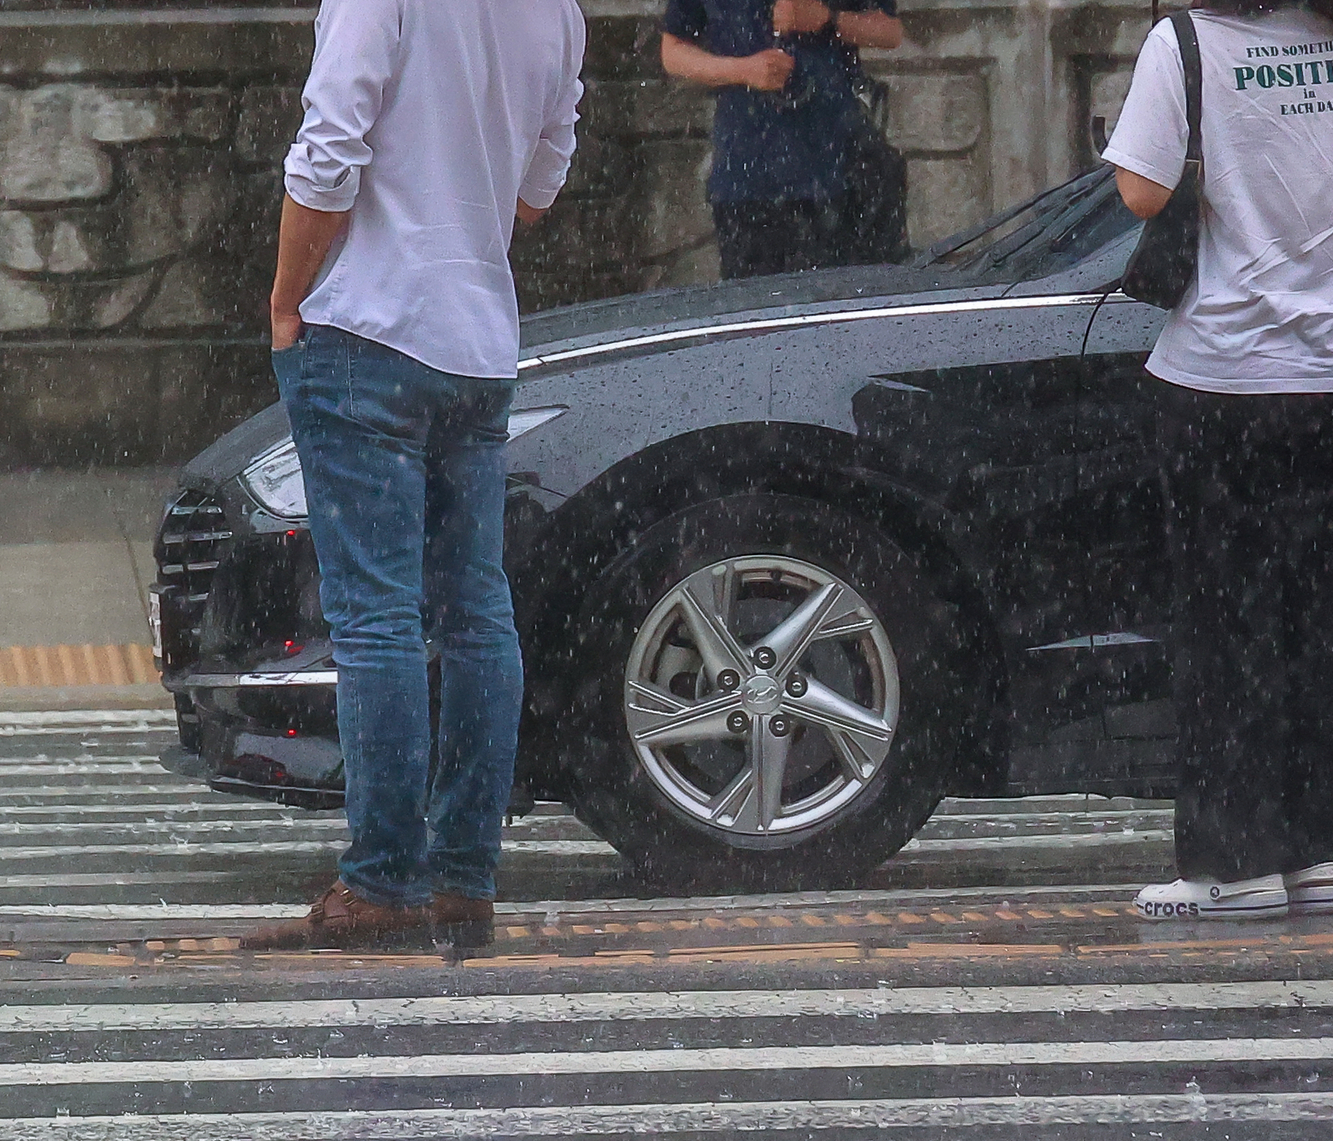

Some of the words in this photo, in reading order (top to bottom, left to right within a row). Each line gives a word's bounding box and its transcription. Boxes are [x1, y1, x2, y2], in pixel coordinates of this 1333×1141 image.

[1246, 46, 1279, 58] FIND
[1303, 88, 1316, 99] in
[1280, 102, 1314, 115] EACH
[1144, 902, 1199, 917] crocs
